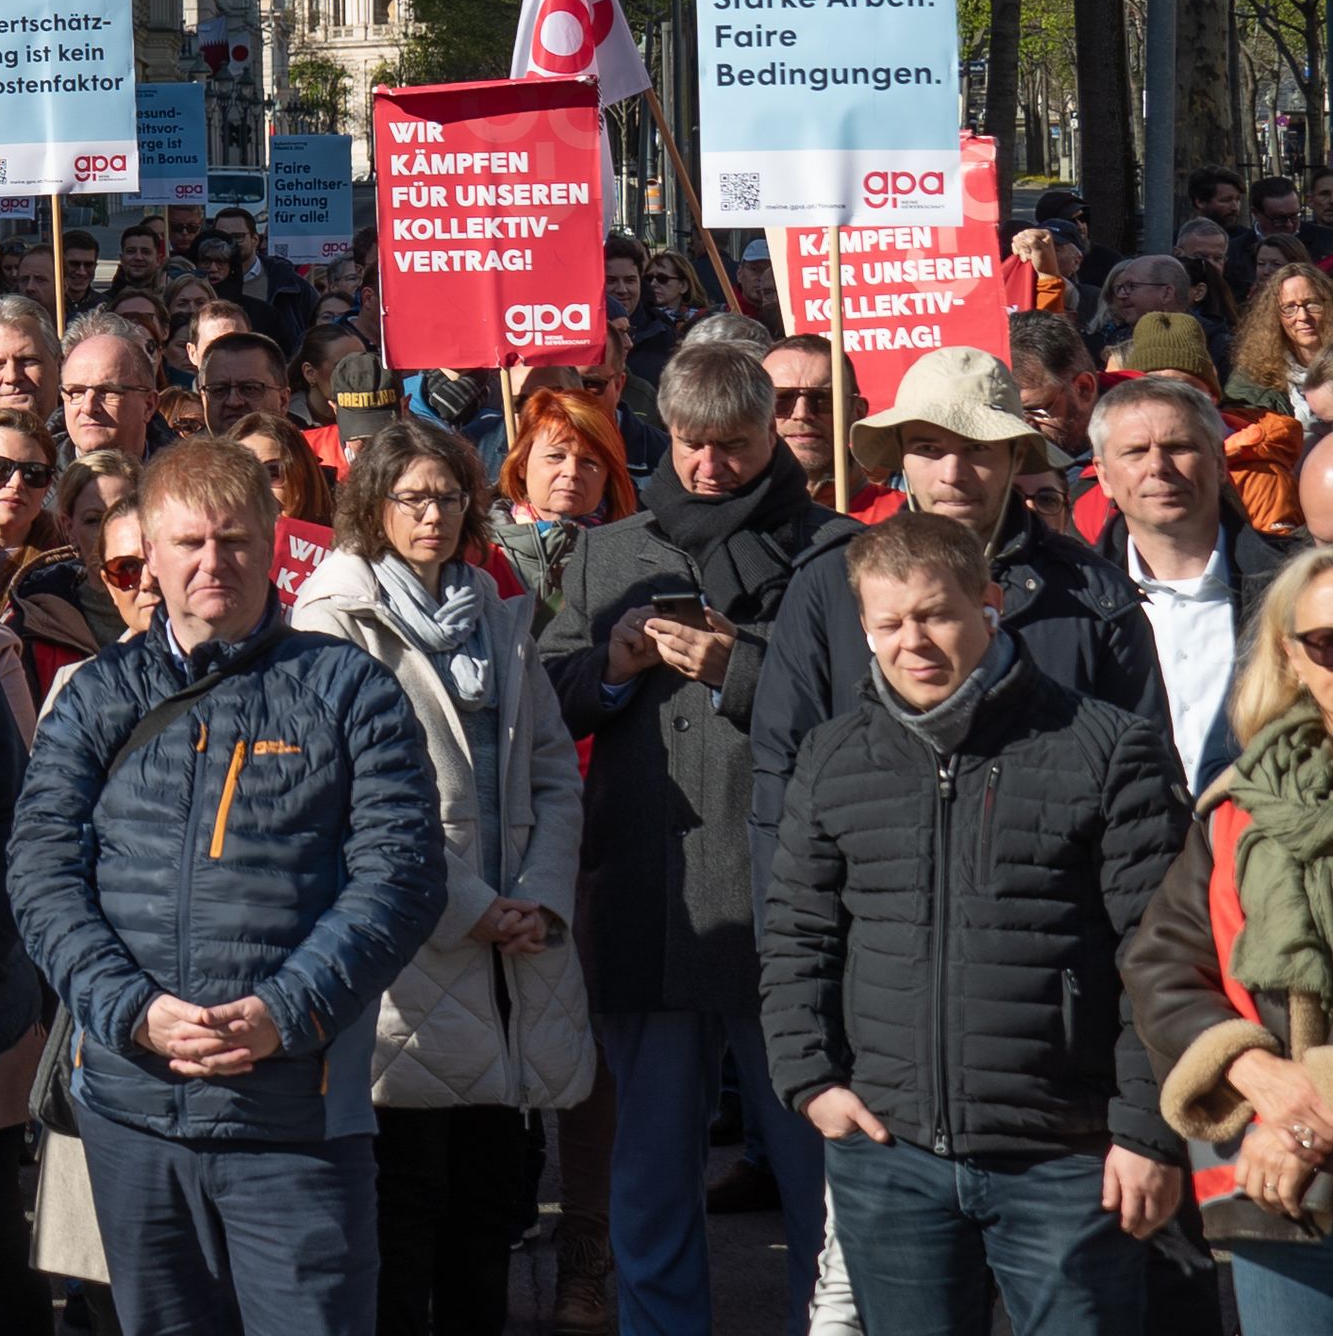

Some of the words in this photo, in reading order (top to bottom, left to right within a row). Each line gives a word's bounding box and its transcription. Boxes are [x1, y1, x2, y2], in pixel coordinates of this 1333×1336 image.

[715, 24, 797, 48] Faire
[26, 44, 51, 63] ist
[58, 44, 104, 62] kein
[716, 62, 942, 91] Bedingungen.
[136, 107, 182, 119] esund-
[137, 124, 185, 134] eitsvor-
[389, 122, 444, 143] WIR
[74, 154, 127, 182] gpa
[158, 154, 198, 164] Bonus
[275, 162, 311, 174] Faire
[390, 149, 528, 176] KÄMPFEN
[175, 184, 203, 199] gpa
[275, 178, 348, 191] Gehaltser-
[392, 182, 448, 208] FÜR
[456, 182, 589, 207] UNSEREN
[863, 171, 945, 209] gpa
[275, 195, 328, 209] höhung
[275, 211, 295, 223] für
[300, 211, 329, 223] alle!
[393, 216, 559, 241] KOLLEKTIV-
[322, 242, 349, 257] gpa
[393, 249, 532, 273] VERTRAG!
[801, 262, 857, 289] FÜR
[862, 255, 993, 285] UNSEREN
[505, 303, 590, 346] gpa
[820, 325, 941, 352] RTRAG!
[337, 390, 396, 408] BREITLING
